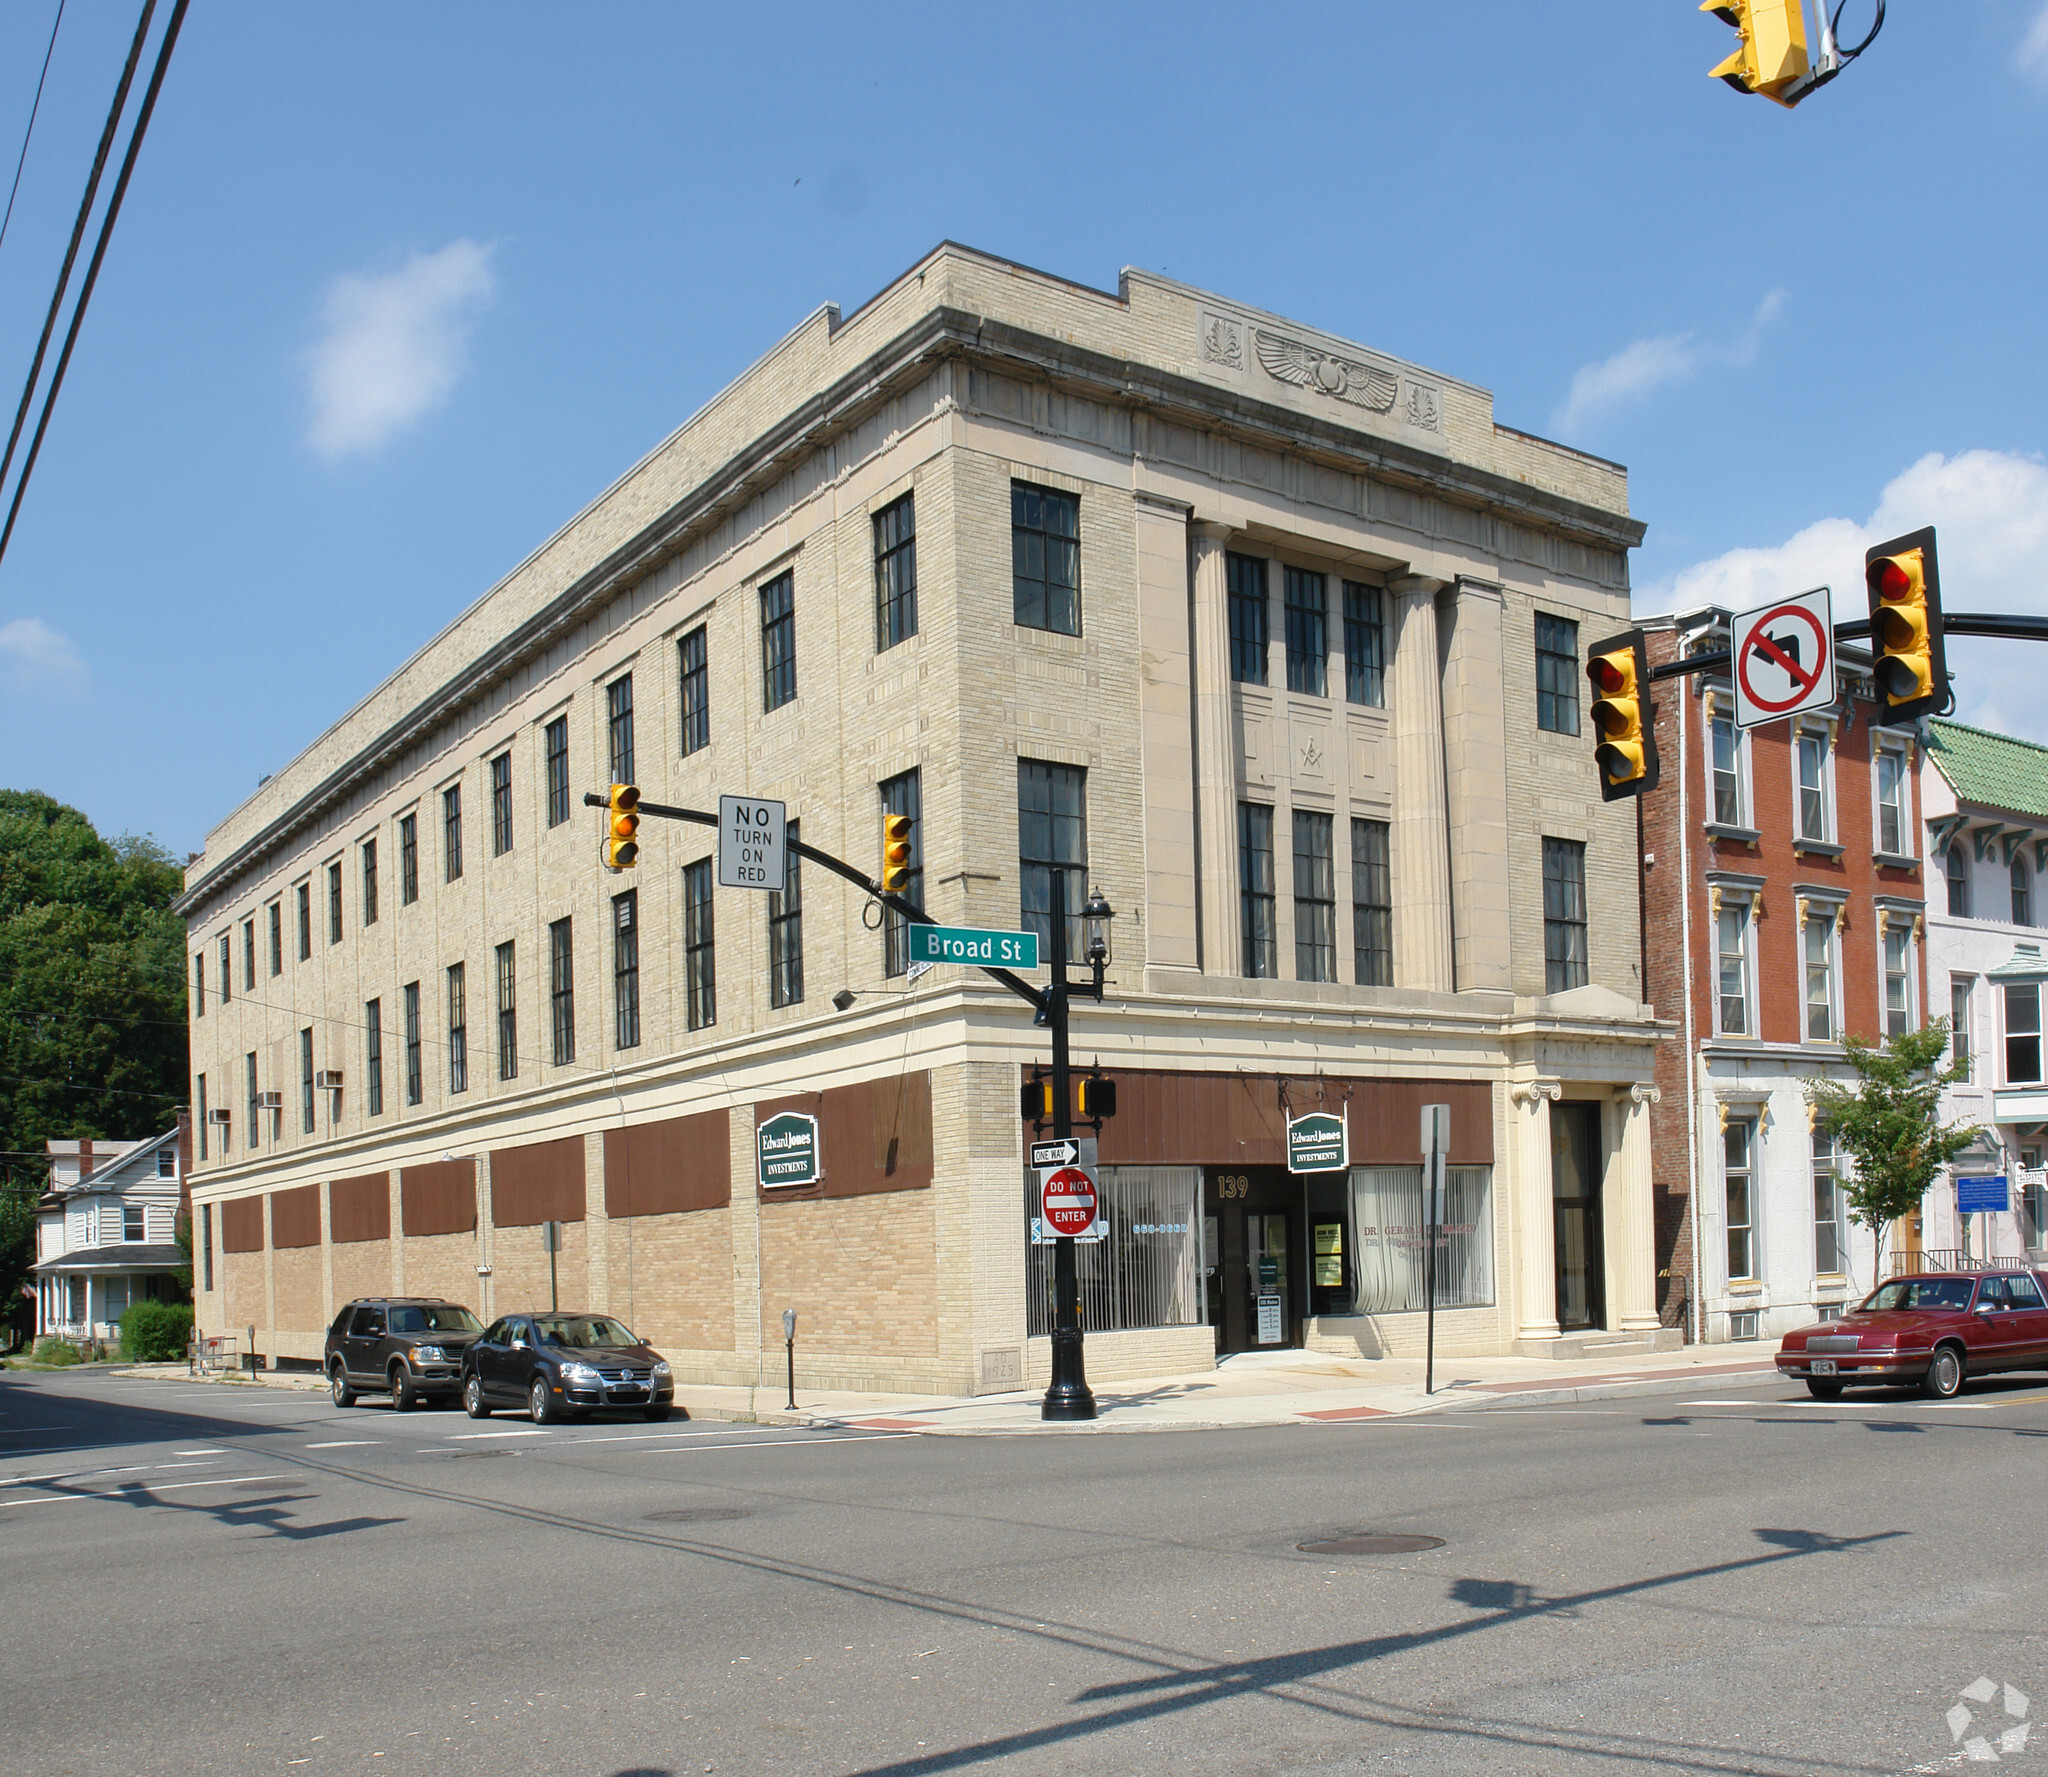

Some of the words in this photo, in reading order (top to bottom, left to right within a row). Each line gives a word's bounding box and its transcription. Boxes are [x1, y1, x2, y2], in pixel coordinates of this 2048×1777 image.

[736, 805, 769, 827] NO
[734, 829, 772, 846] TURN
[741, 848, 763, 863] ON
[738, 866, 766, 882] RED
[927, 933, 992, 959] Broad
[1001, 938, 1021, 961] St
[1035, 1150, 1049, 1161] ONE
[1051, 1148, 1065, 1160] WAY
[1296, 1151, 1337, 1162] INVESTMENTS
[768, 1160, 808, 1175] INVESTMENTS
[1050, 1181, 1064, 1193] DO
[1069, 1181, 1089, 1192] NOT
[1218, 1175, 1249, 1199] 139
[1055, 1211, 1087, 1222] ENTER
[1364, 1226, 1379, 1236] DR.
[1384, 1225, 1423, 1235] GERALD
[988, 1364, 1014, 1378] 1925
